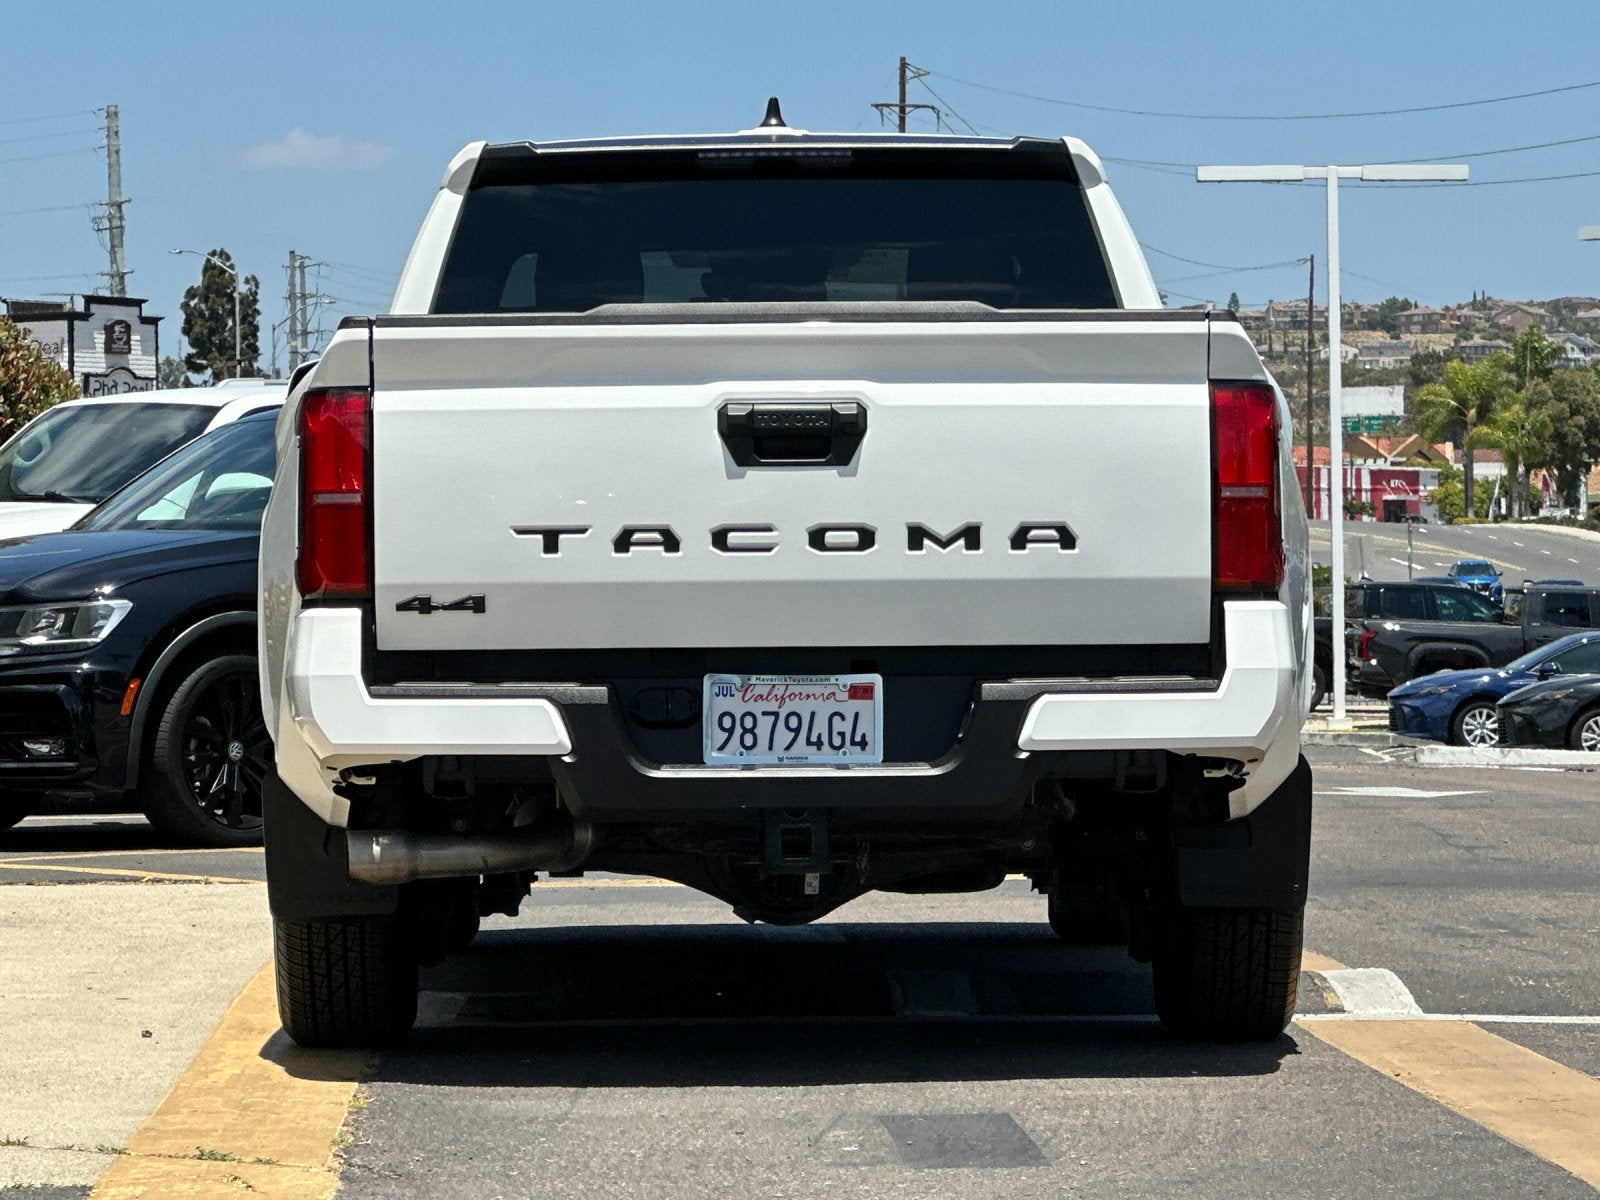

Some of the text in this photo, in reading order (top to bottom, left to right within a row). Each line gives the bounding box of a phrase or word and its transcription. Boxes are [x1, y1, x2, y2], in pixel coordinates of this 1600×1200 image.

[757, 414, 828, 426] TOYOTA
[510, 521, 1079, 556] TACOMA
[715, 685, 735, 697] JUL
[741, 684, 848, 709] California
[717, 711, 868, 751] 98794G4
